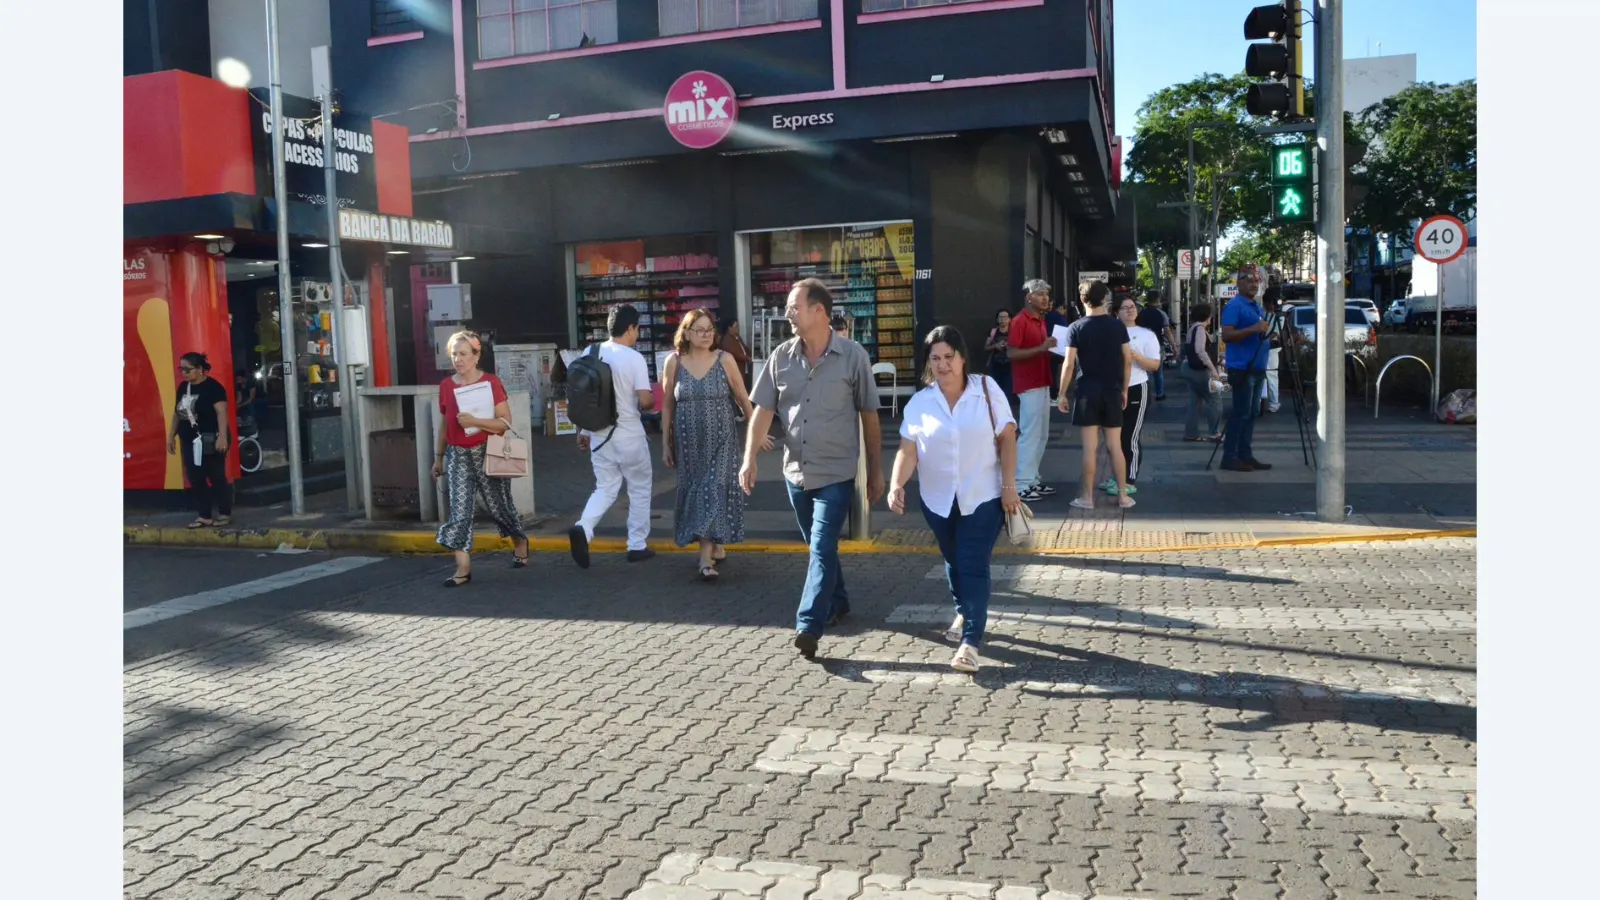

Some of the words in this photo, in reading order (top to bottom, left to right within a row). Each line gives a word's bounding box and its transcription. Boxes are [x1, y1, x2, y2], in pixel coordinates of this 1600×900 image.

[668, 91, 729, 124] mix
[262, 112, 305, 140] CPAS
[772, 112, 834, 131] Express
[1279, 151, 1303, 176] 06
[340, 210, 390, 242] BANCA
[390, 218, 412, 243] DA
[411, 220, 453, 249] BARÃO
[1426, 228, 1454, 245] 40
[915, 269, 932, 280] 1161
